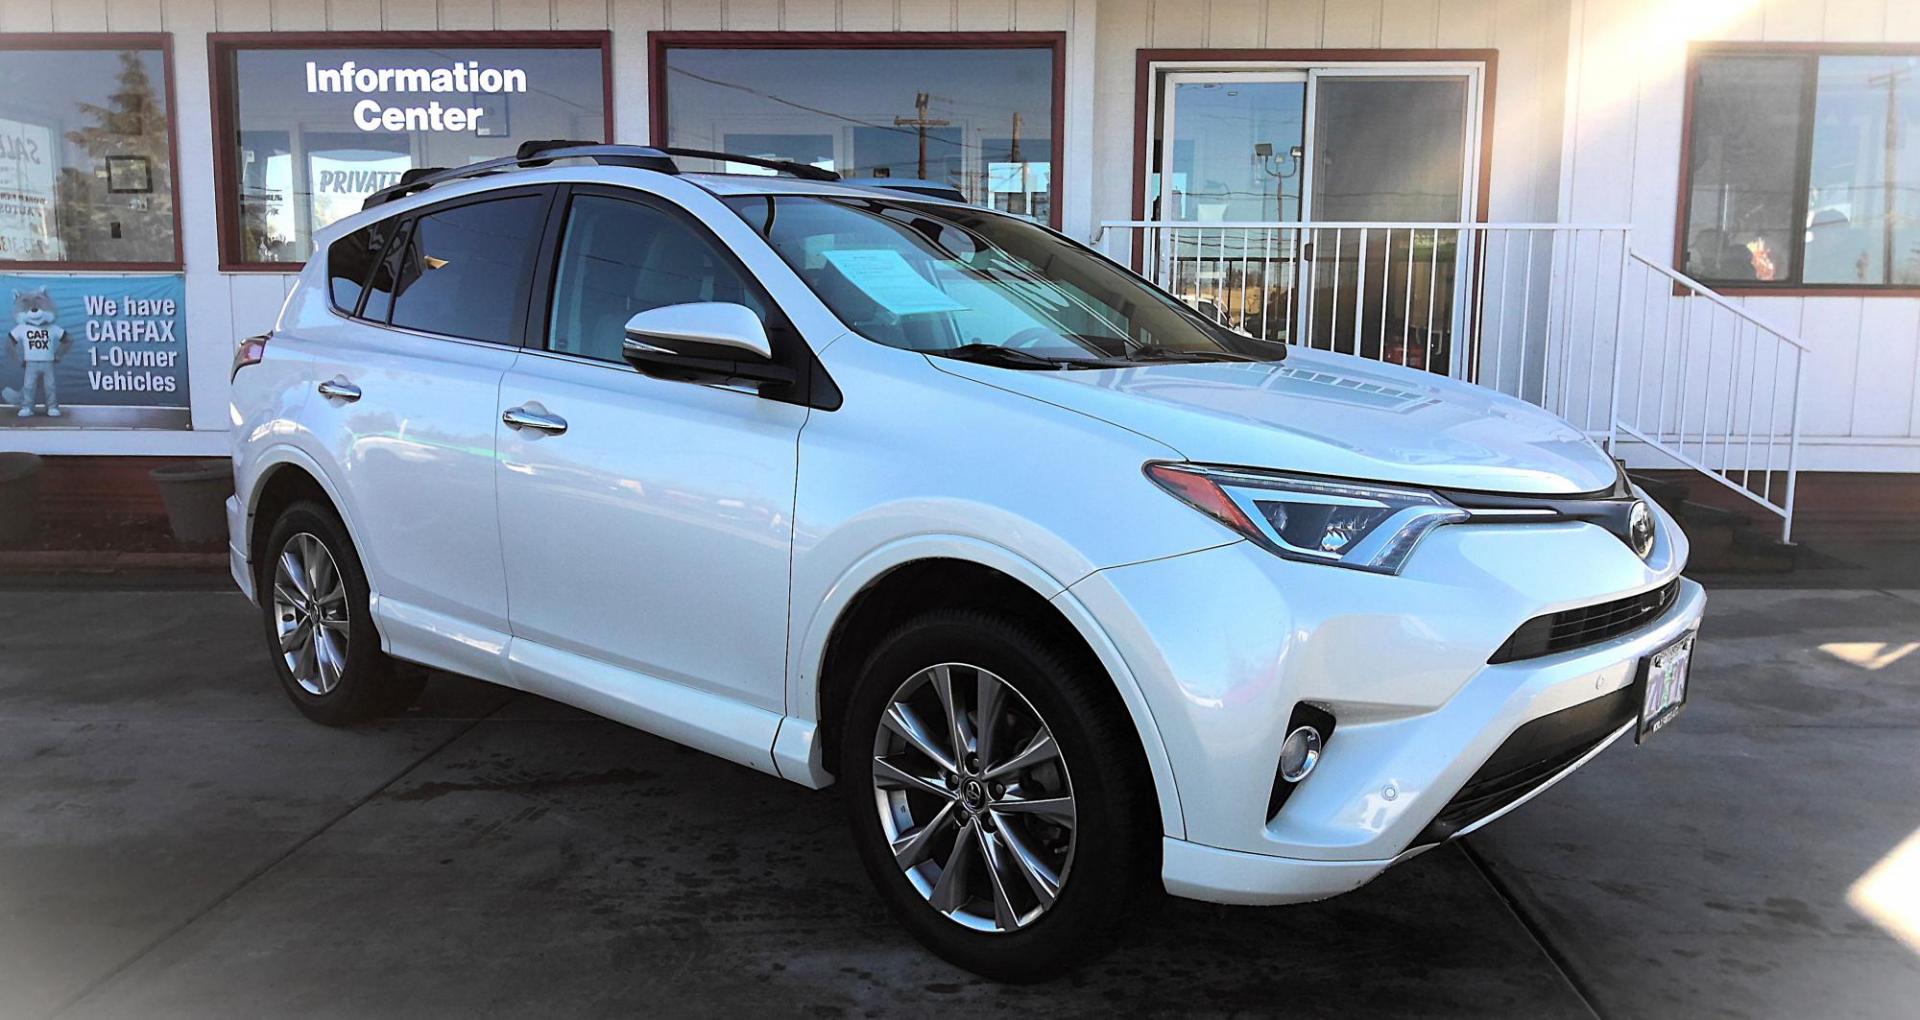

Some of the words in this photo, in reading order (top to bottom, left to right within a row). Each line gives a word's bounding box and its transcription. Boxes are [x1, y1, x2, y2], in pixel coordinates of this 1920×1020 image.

[306, 61, 527, 92] Information
[353, 99, 483, 131] Center
[84, 295, 117, 316] We
[124, 296, 175, 316] have
[26, 330, 49, 340] CAR
[86, 320, 175, 342] CARFAX
[29, 340, 49, 350] FOX
[88, 346, 177, 367] 1-Owner
[88, 370, 176, 392] Vehicles
